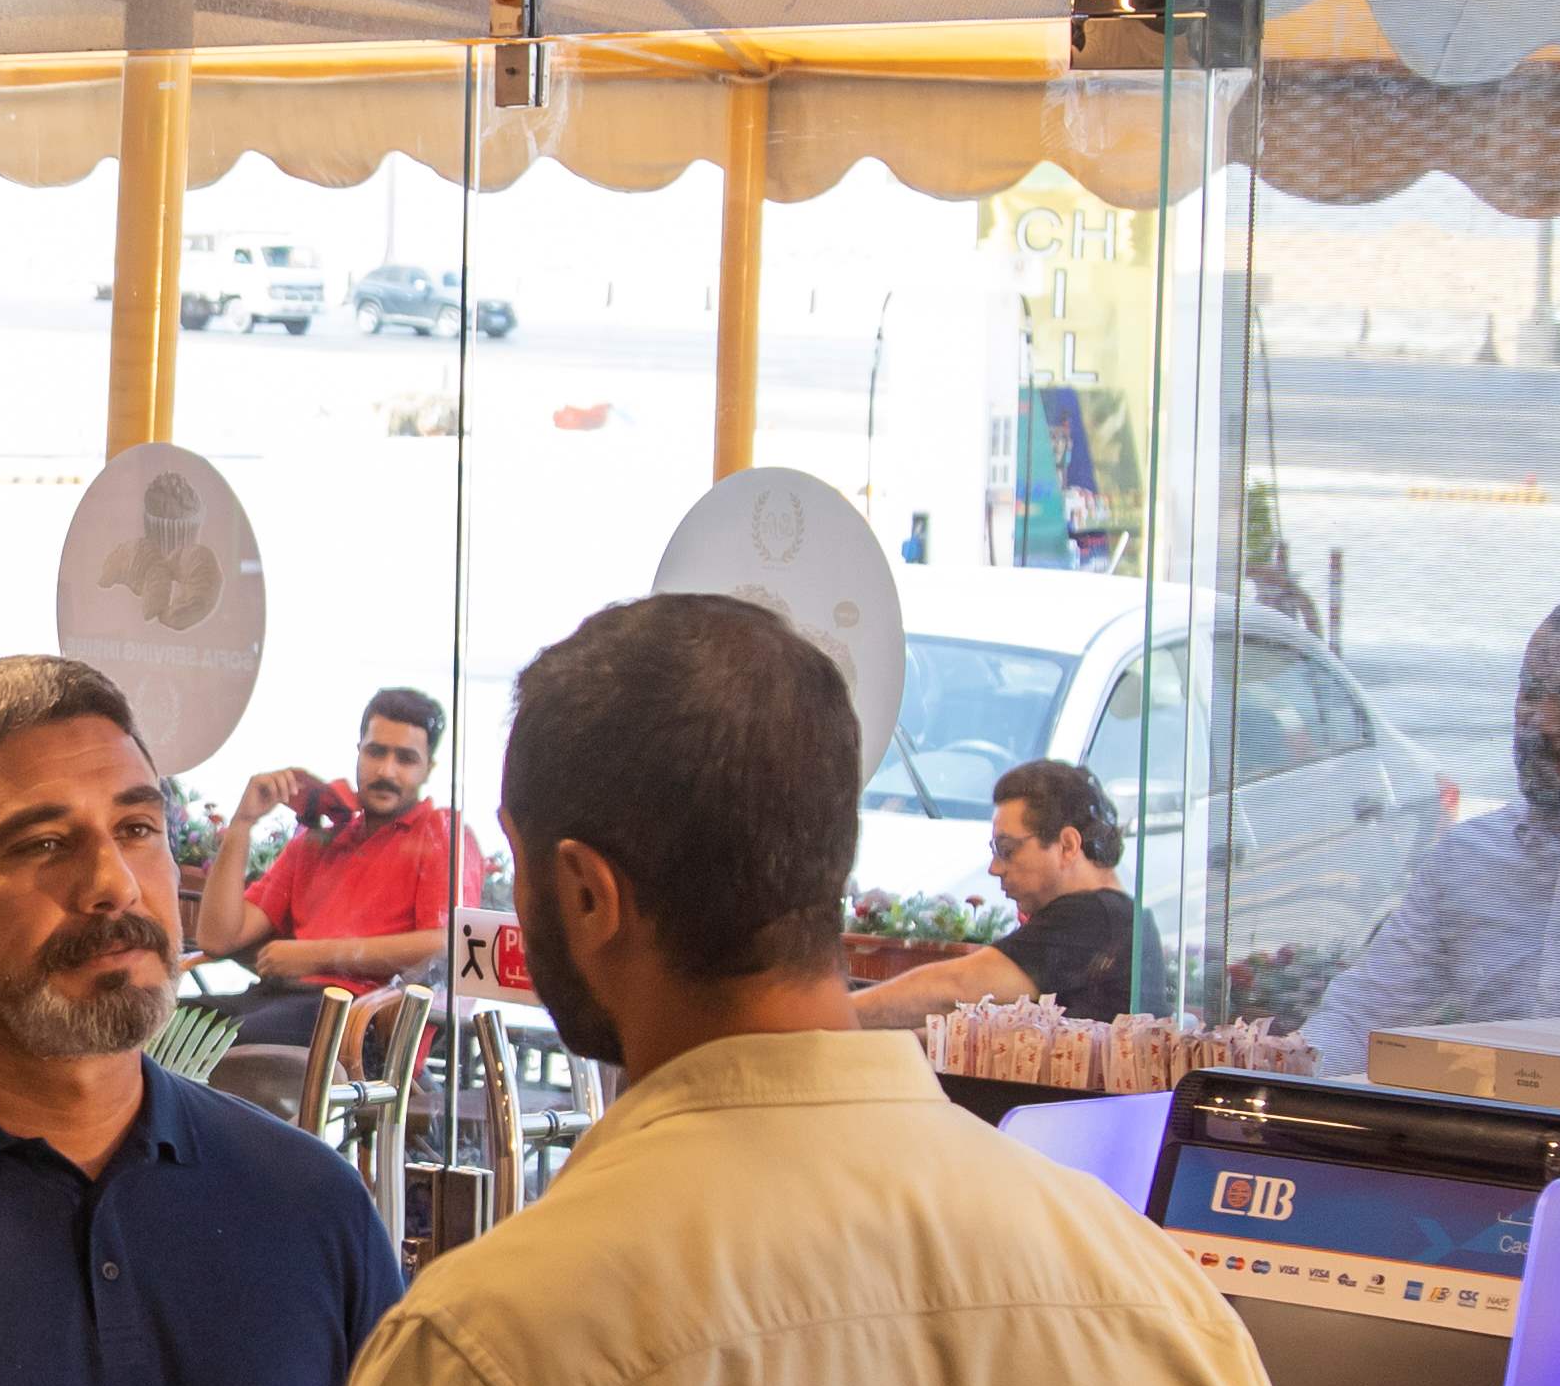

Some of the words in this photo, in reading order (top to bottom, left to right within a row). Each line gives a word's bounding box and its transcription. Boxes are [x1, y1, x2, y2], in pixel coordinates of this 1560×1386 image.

[1016, 207, 1117, 262] CH
[1211, 1171, 1296, 1221] CIB
[1279, 1265, 1300, 1276] VISA
[1308, 1268, 1330, 1279] VISA
